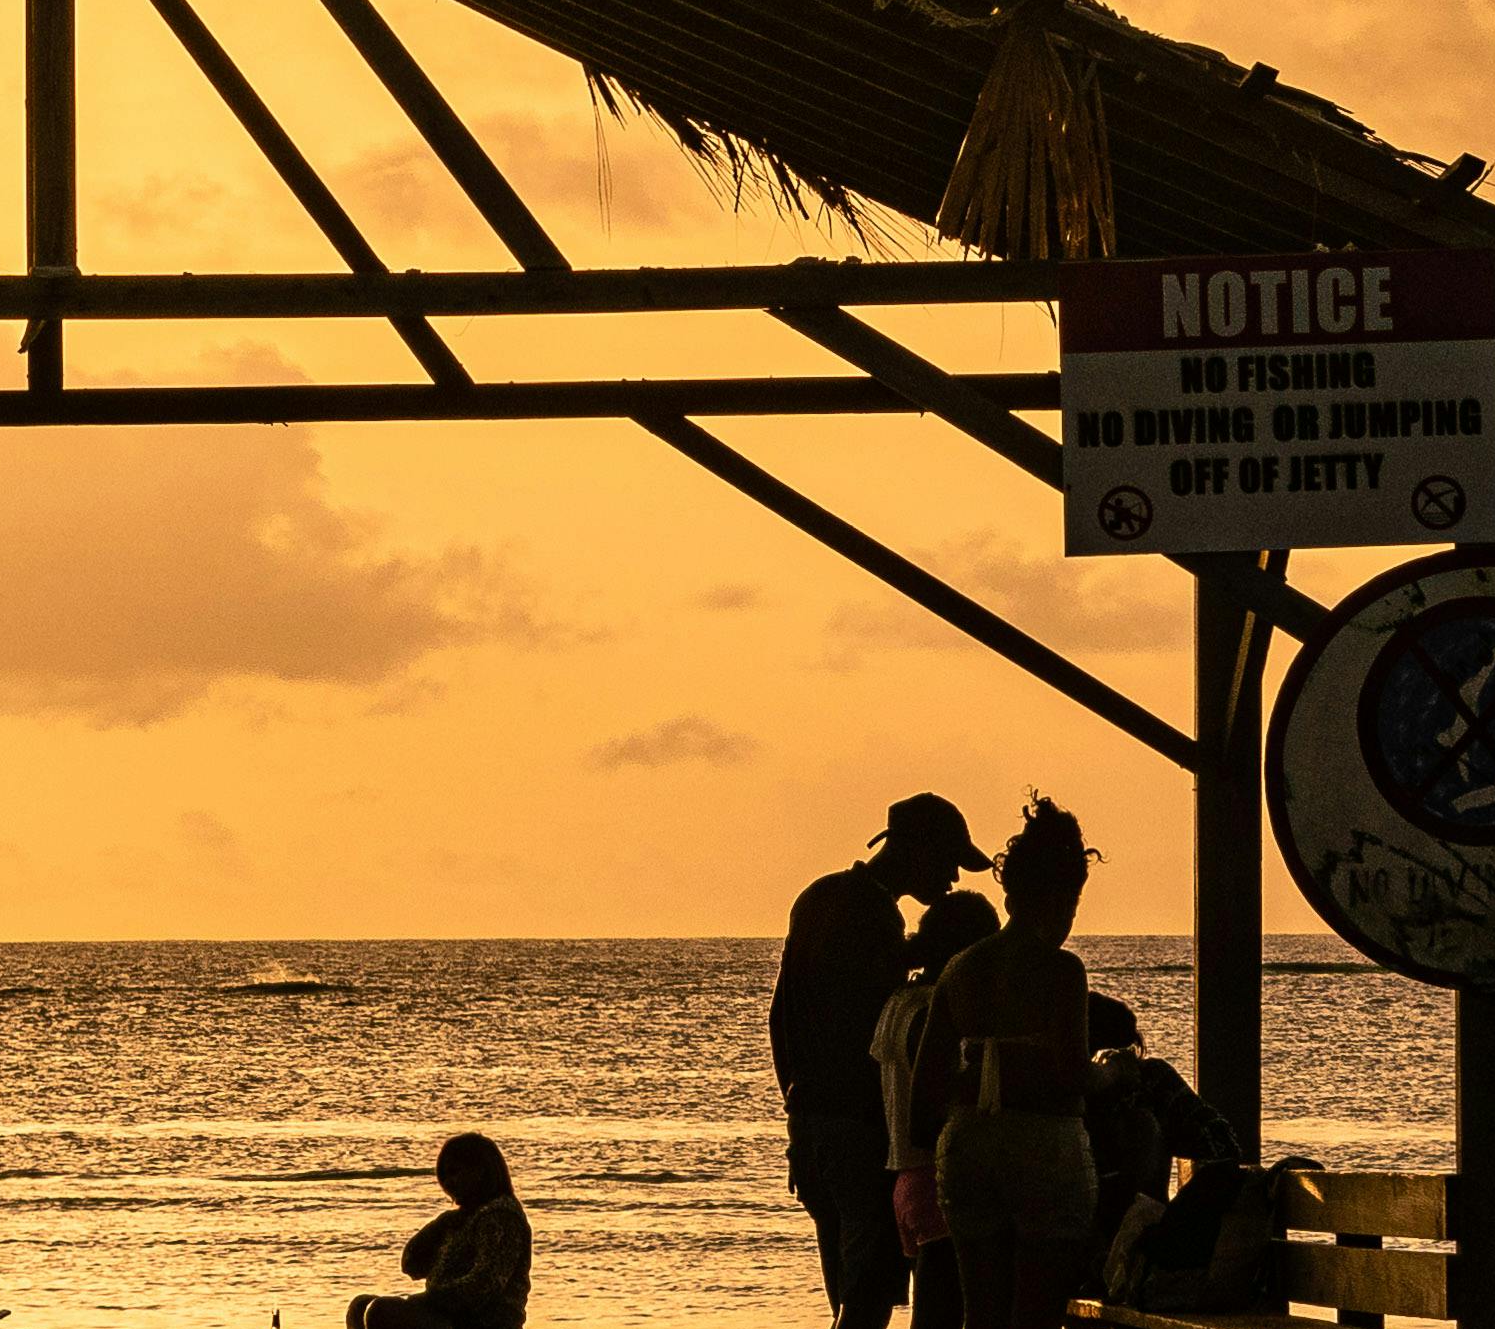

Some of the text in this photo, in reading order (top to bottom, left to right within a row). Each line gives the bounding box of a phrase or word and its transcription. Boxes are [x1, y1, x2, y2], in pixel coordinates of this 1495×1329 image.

[1161, 267, 1394, 338] NOTICE
[1181, 352, 1376, 393] NO FISHING
[1078, 398, 1482, 448] NO DIVING OR JUMPING
[1170, 453, 1385, 496] OFF OF JETTY
